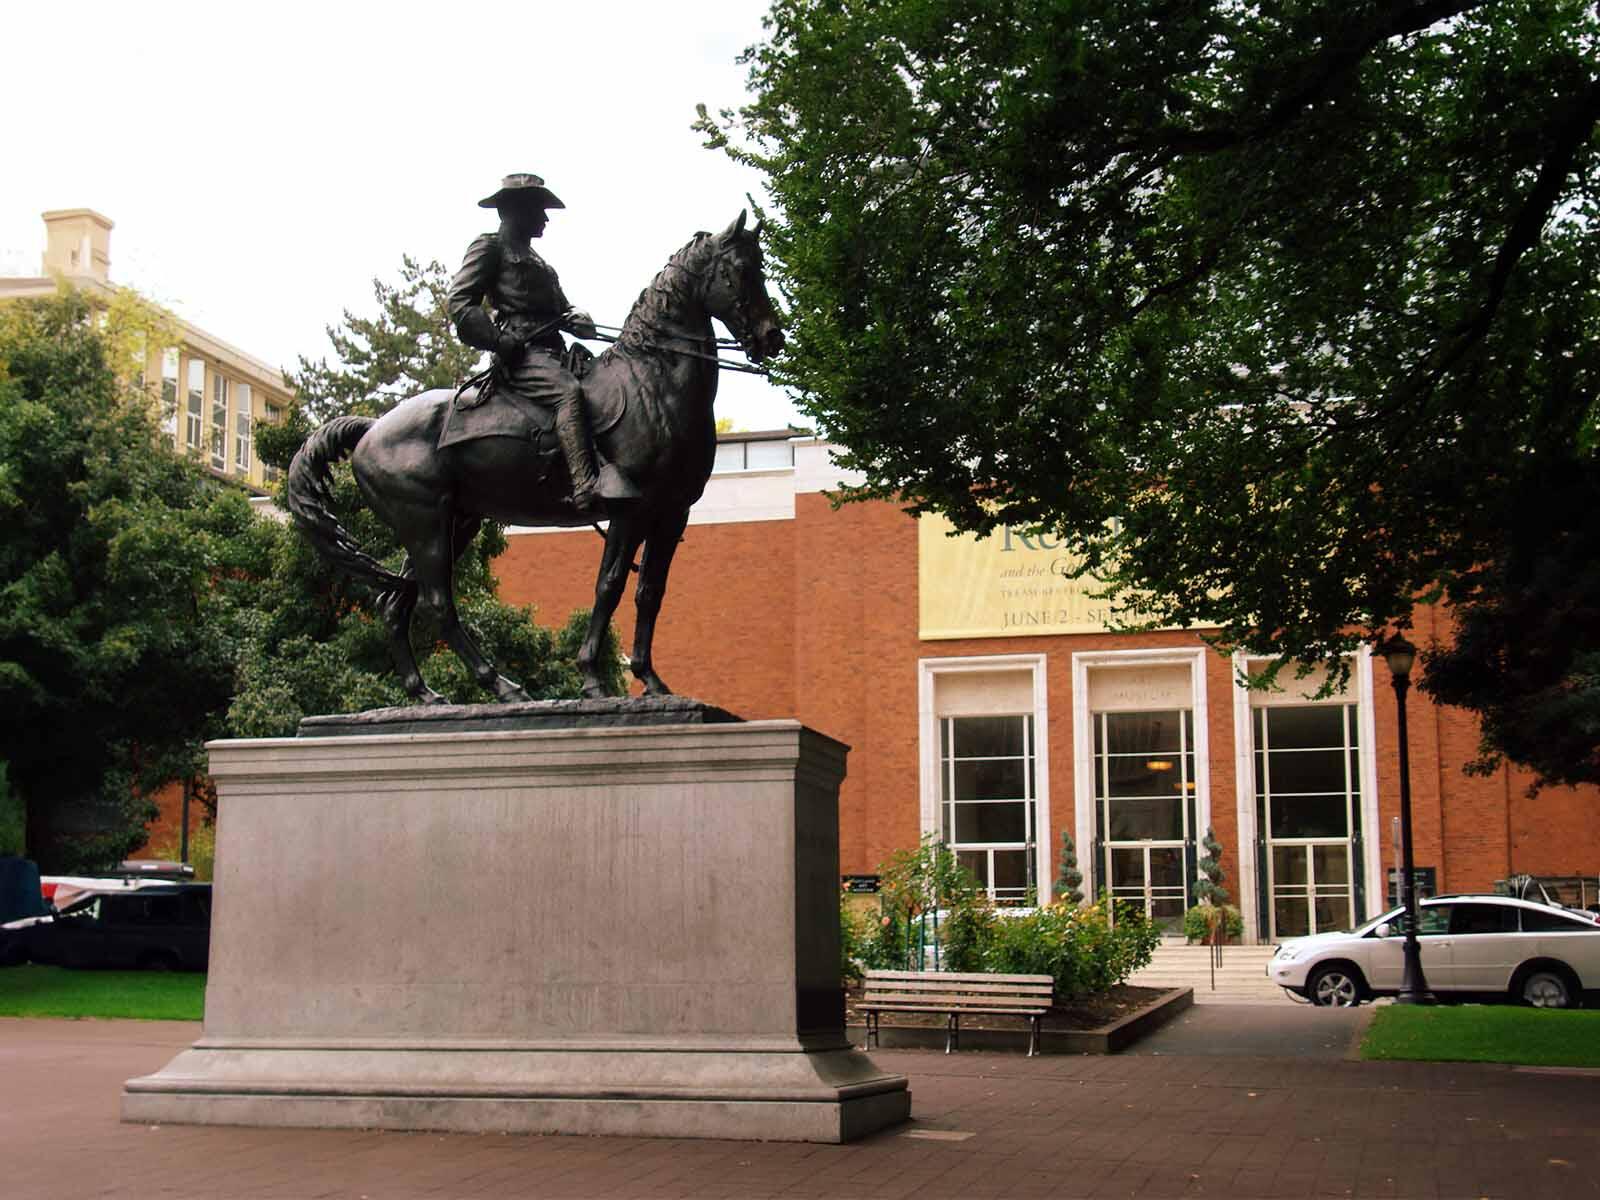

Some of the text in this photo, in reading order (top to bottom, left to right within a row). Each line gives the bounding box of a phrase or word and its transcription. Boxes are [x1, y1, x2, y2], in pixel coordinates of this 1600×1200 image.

[1000, 565, 1025, 577] and
[1027, 563, 1045, 577] the
[1001, 611, 1052, 630] JUNE
[1059, 610, 1068, 624] 2
